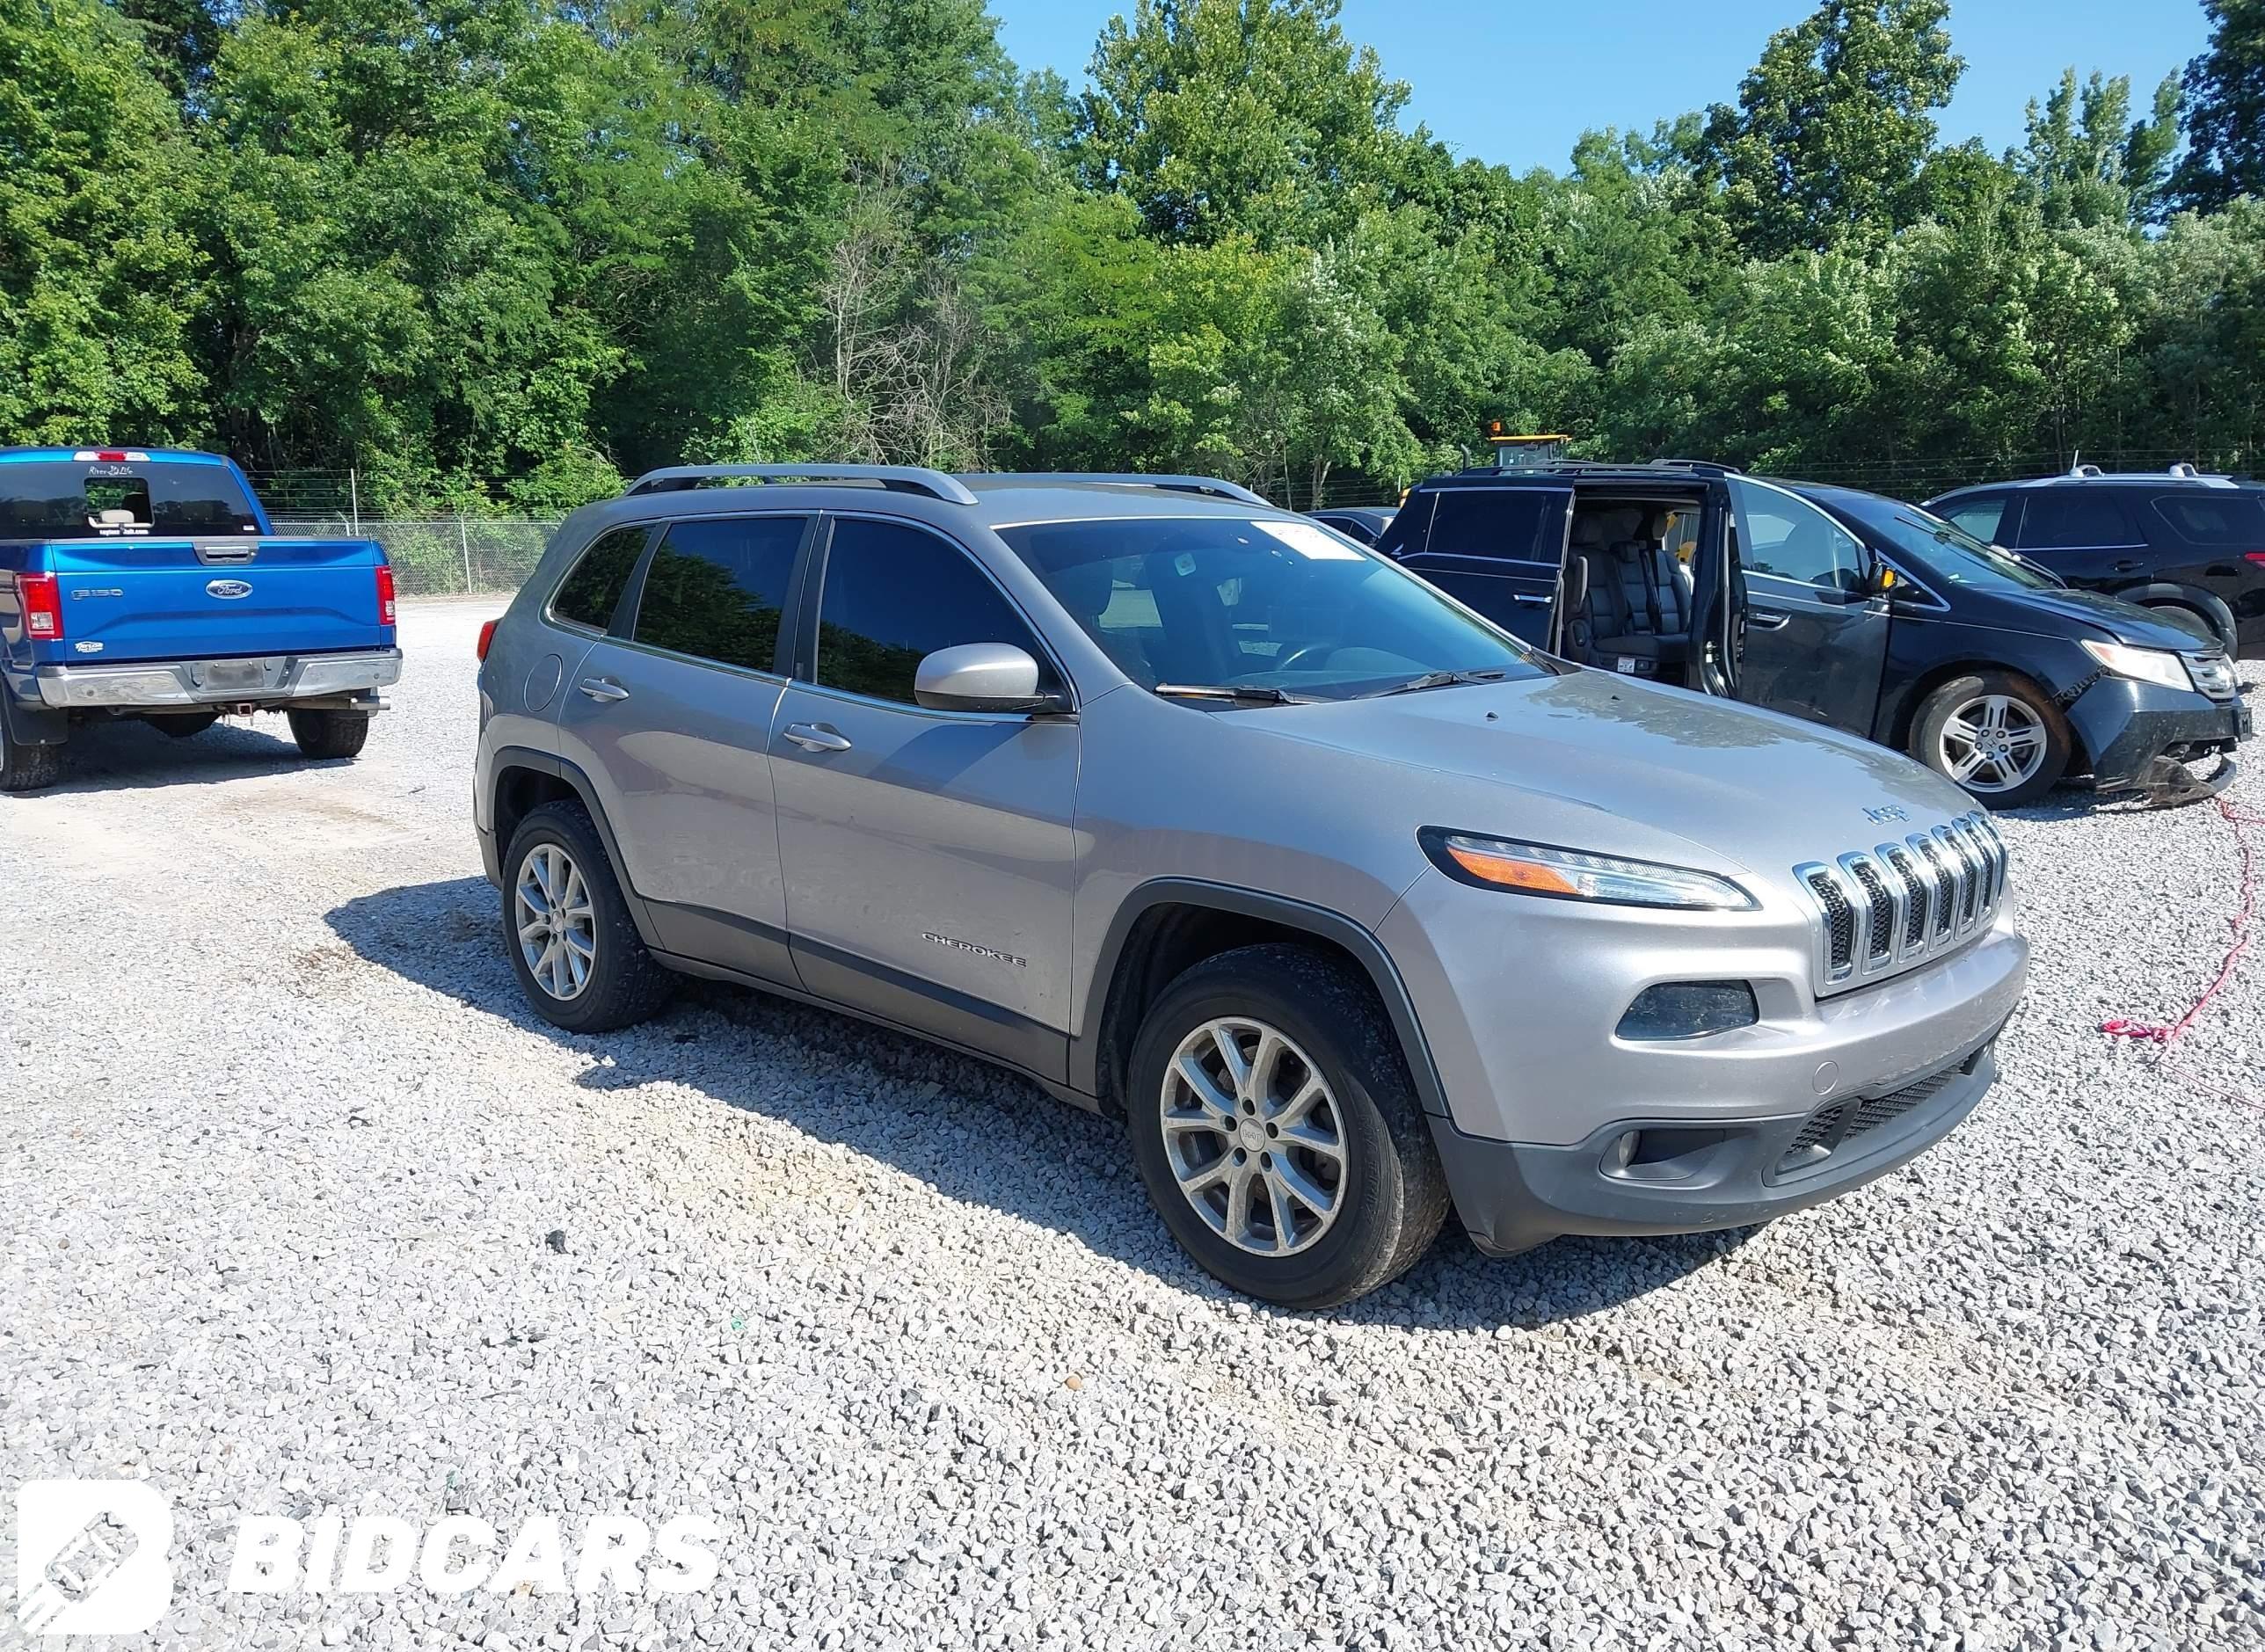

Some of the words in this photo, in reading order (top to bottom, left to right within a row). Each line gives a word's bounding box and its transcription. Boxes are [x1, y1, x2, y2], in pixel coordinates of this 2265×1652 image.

[217, 583, 243, 595] Ford
[1861, 804, 1911, 825] Jeep
[922, 932, 1027, 968] CHEROKEE
